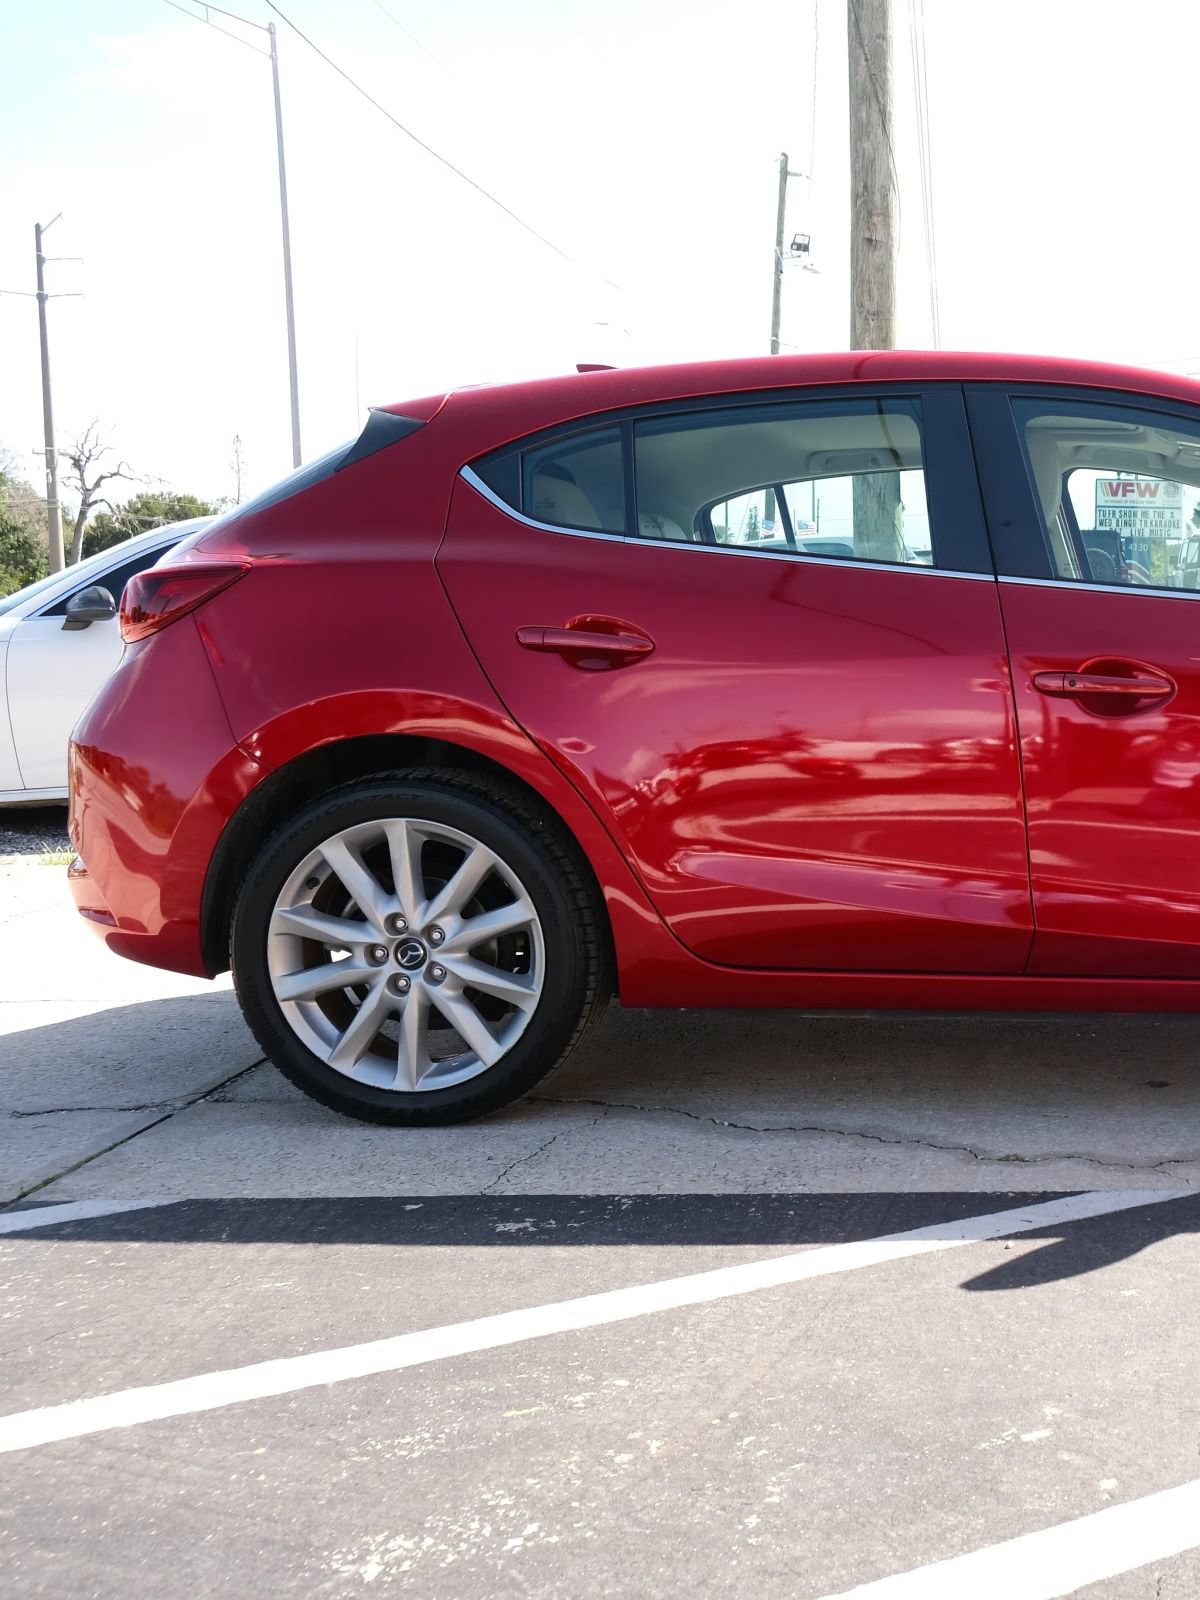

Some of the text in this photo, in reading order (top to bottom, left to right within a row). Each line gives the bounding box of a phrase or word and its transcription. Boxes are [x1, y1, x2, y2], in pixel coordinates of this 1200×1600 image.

[1106, 482, 1160, 498] VFW
[1118, 510, 1138, 518] SHOW
[1153, 510, 1165, 519] THE
[1116, 519, 1136, 527] BINGO
[1150, 520, 1180, 528] KARAOKE
[1131, 528, 1144, 536] LIVE
[1149, 529, 1171, 537] MUSIC
